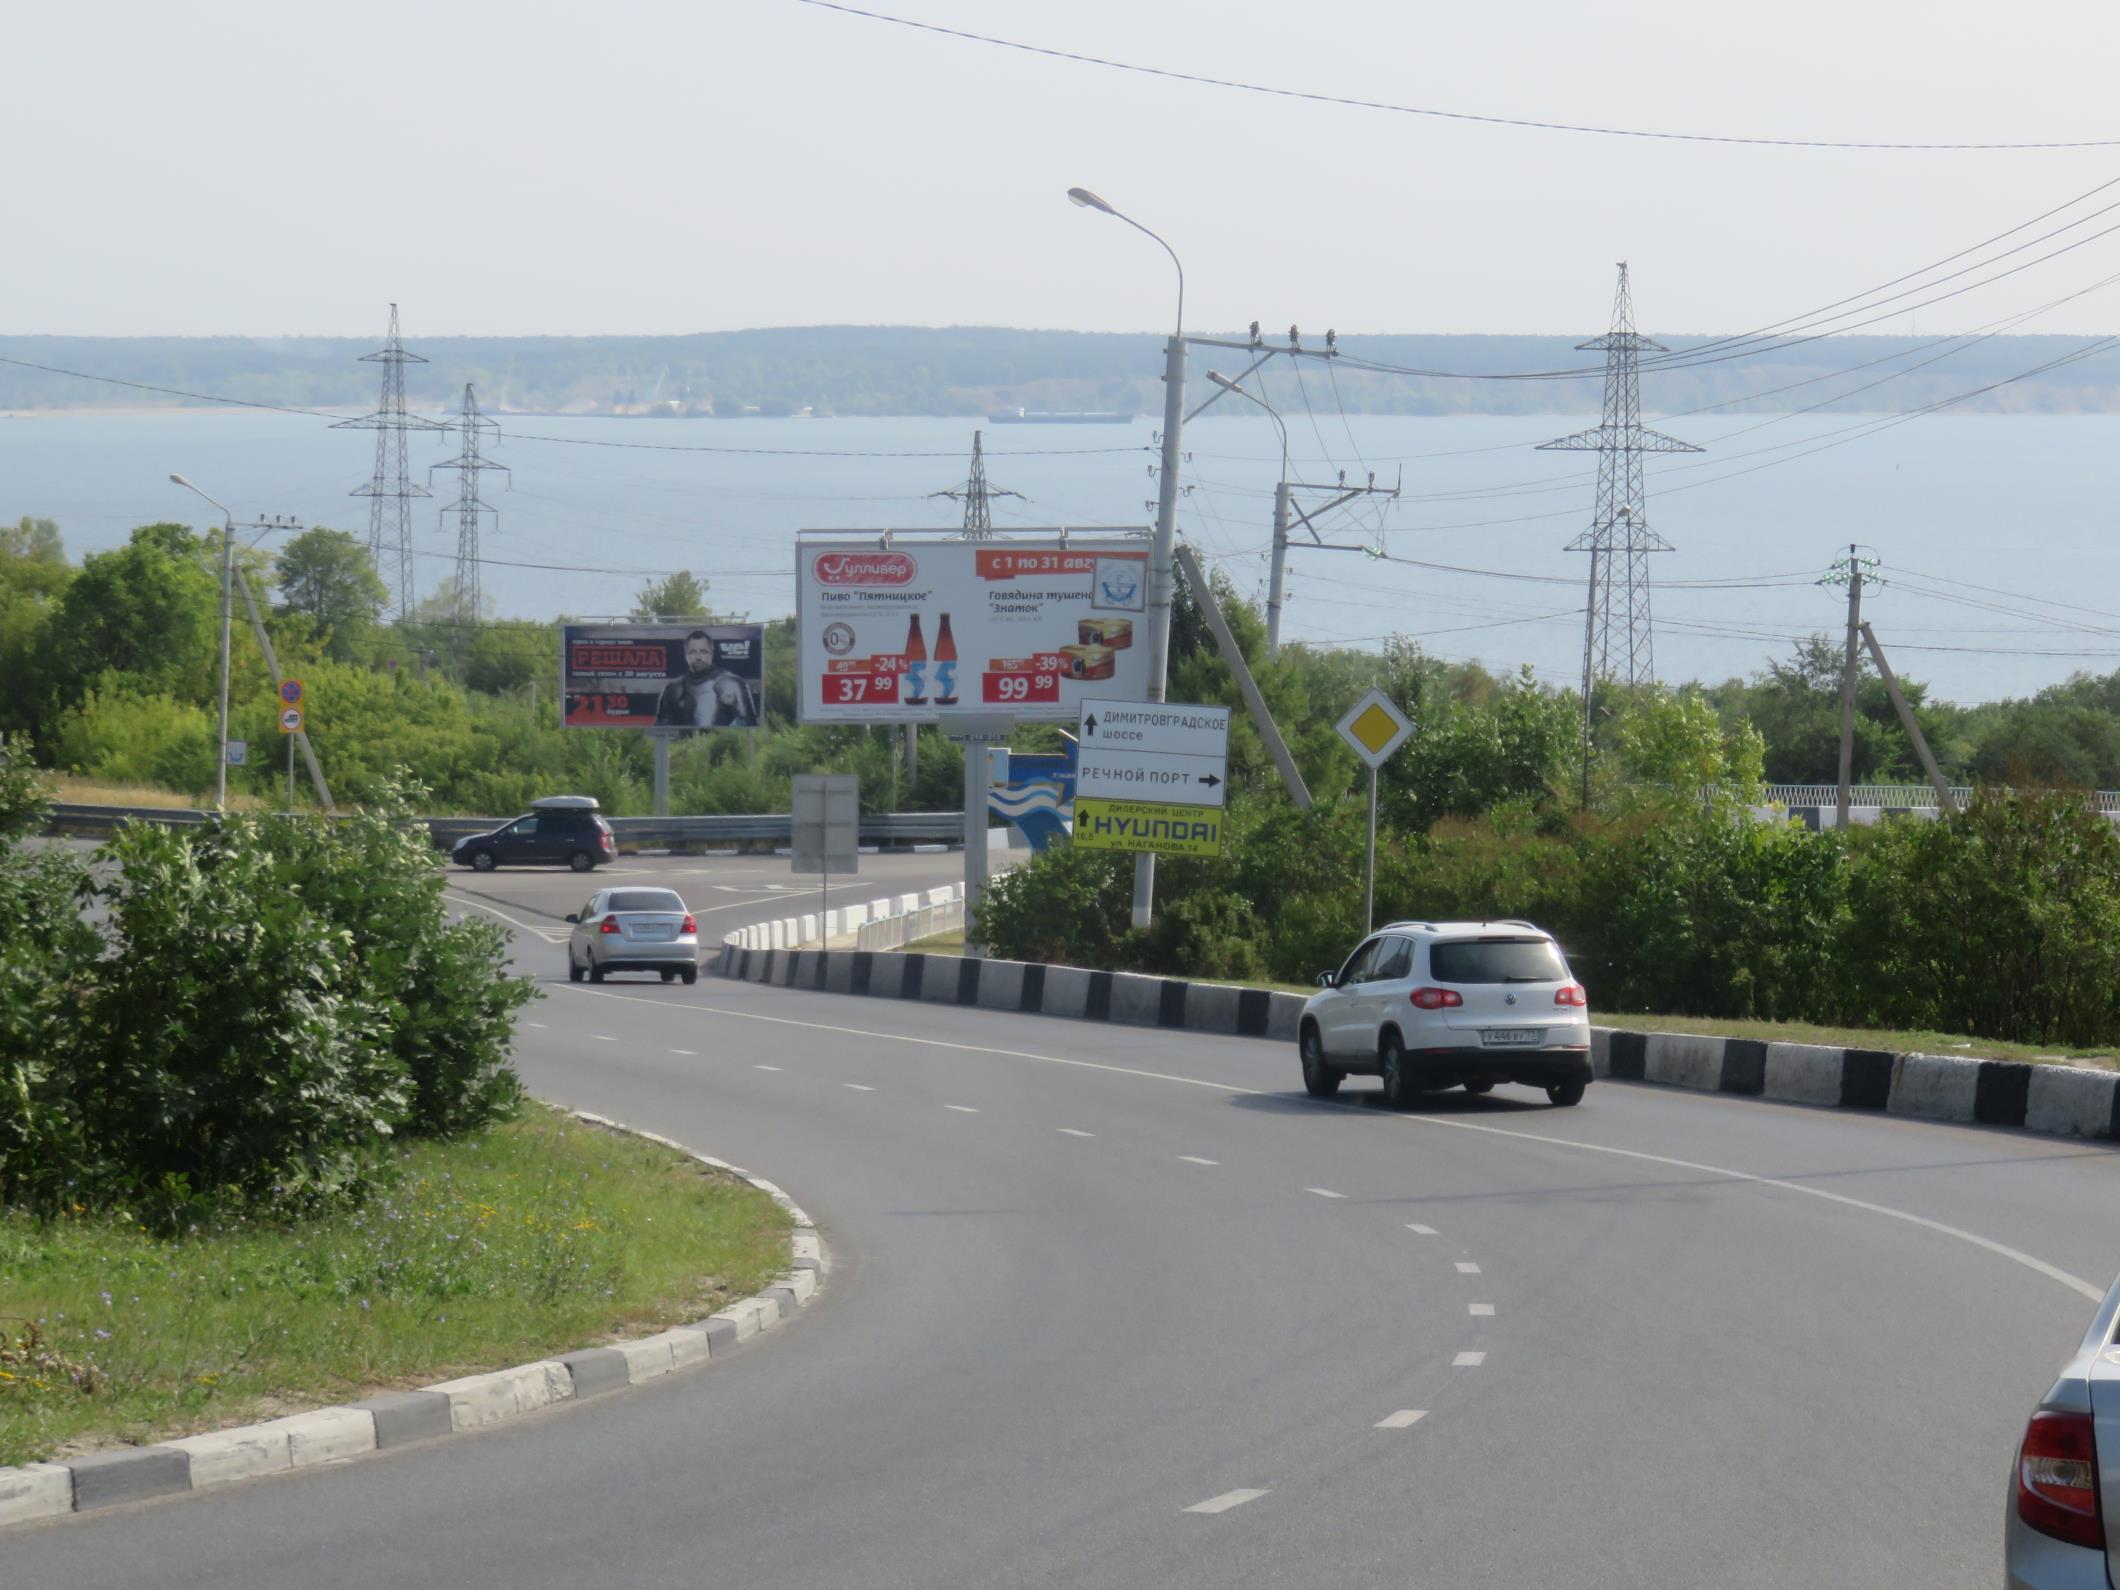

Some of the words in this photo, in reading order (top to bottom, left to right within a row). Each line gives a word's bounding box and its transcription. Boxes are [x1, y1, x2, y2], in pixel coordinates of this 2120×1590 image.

[823, 557, 907, 581] Гулливер
[1005, 556, 1013, 568] 1
[1018, 557, 1038, 568] по
[1041, 556, 1059, 569] 31
[1063, 557, 1095, 571] авг
[822, 591, 850, 601] Пиво
[854, 590, 933, 603] "Пятницкое"
[989, 590, 1043, 601] Говядина
[989, 602, 1044, 613] "Знаток"
[577, 651, 661, 666] РЕШАЛА
[839, 679, 867, 701] 37
[875, 676, 892, 690] 99
[999, 677, 1029, 699] 99
[1035, 675, 1052, 688] 99
[1103, 711, 1226, 730] ДИМИТРОВГРАДСКОЕ
[1103, 730, 1143, 741] шоссе
[1082, 767, 1144, 782] РЕЧНОЙ
[1150, 771, 1190, 784] ПОРТ
[1108, 803, 1168, 816] ДИЛЕРСКИЙ
[1172, 810, 1204, 818] ЦЕНТР
[1094, 816, 1217, 843] HYUNDAI
